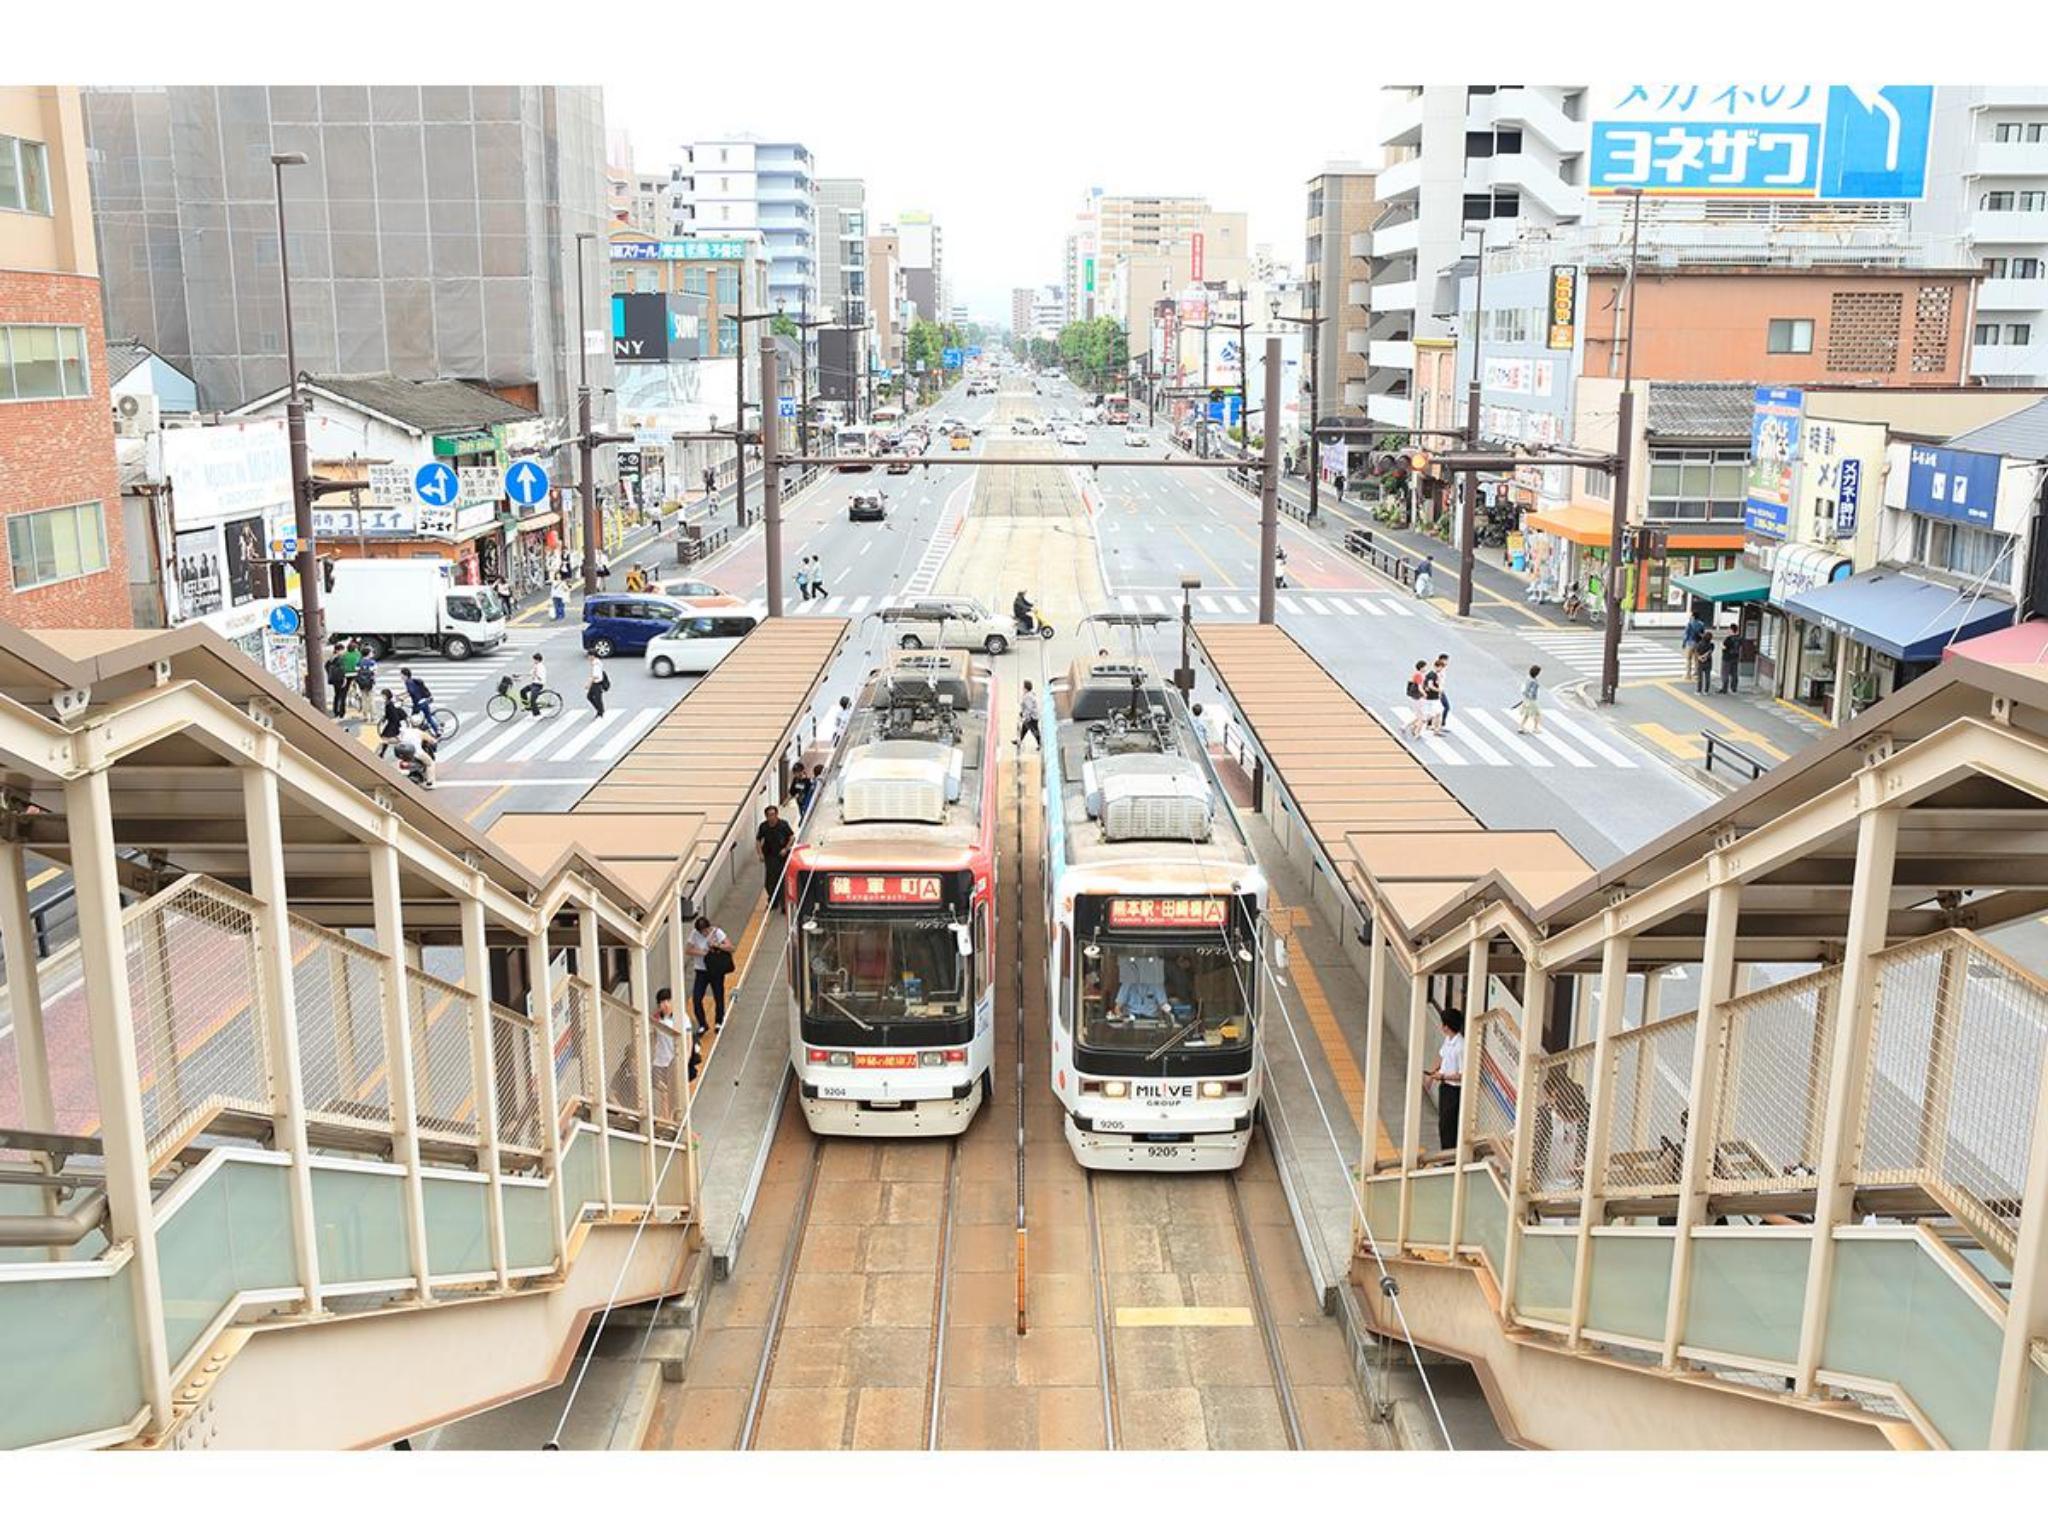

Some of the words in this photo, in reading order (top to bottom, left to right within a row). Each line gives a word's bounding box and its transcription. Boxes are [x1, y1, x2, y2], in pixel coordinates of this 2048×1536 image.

[1602, 126, 1809, 184] ヨネザワ
[1838, 461, 1858, 527] メガネ時計
[824, 1087, 846, 1097] 9204
[1100, 1120, 1125, 1130] 9205
[1148, 1147, 1178, 1158] 9205
